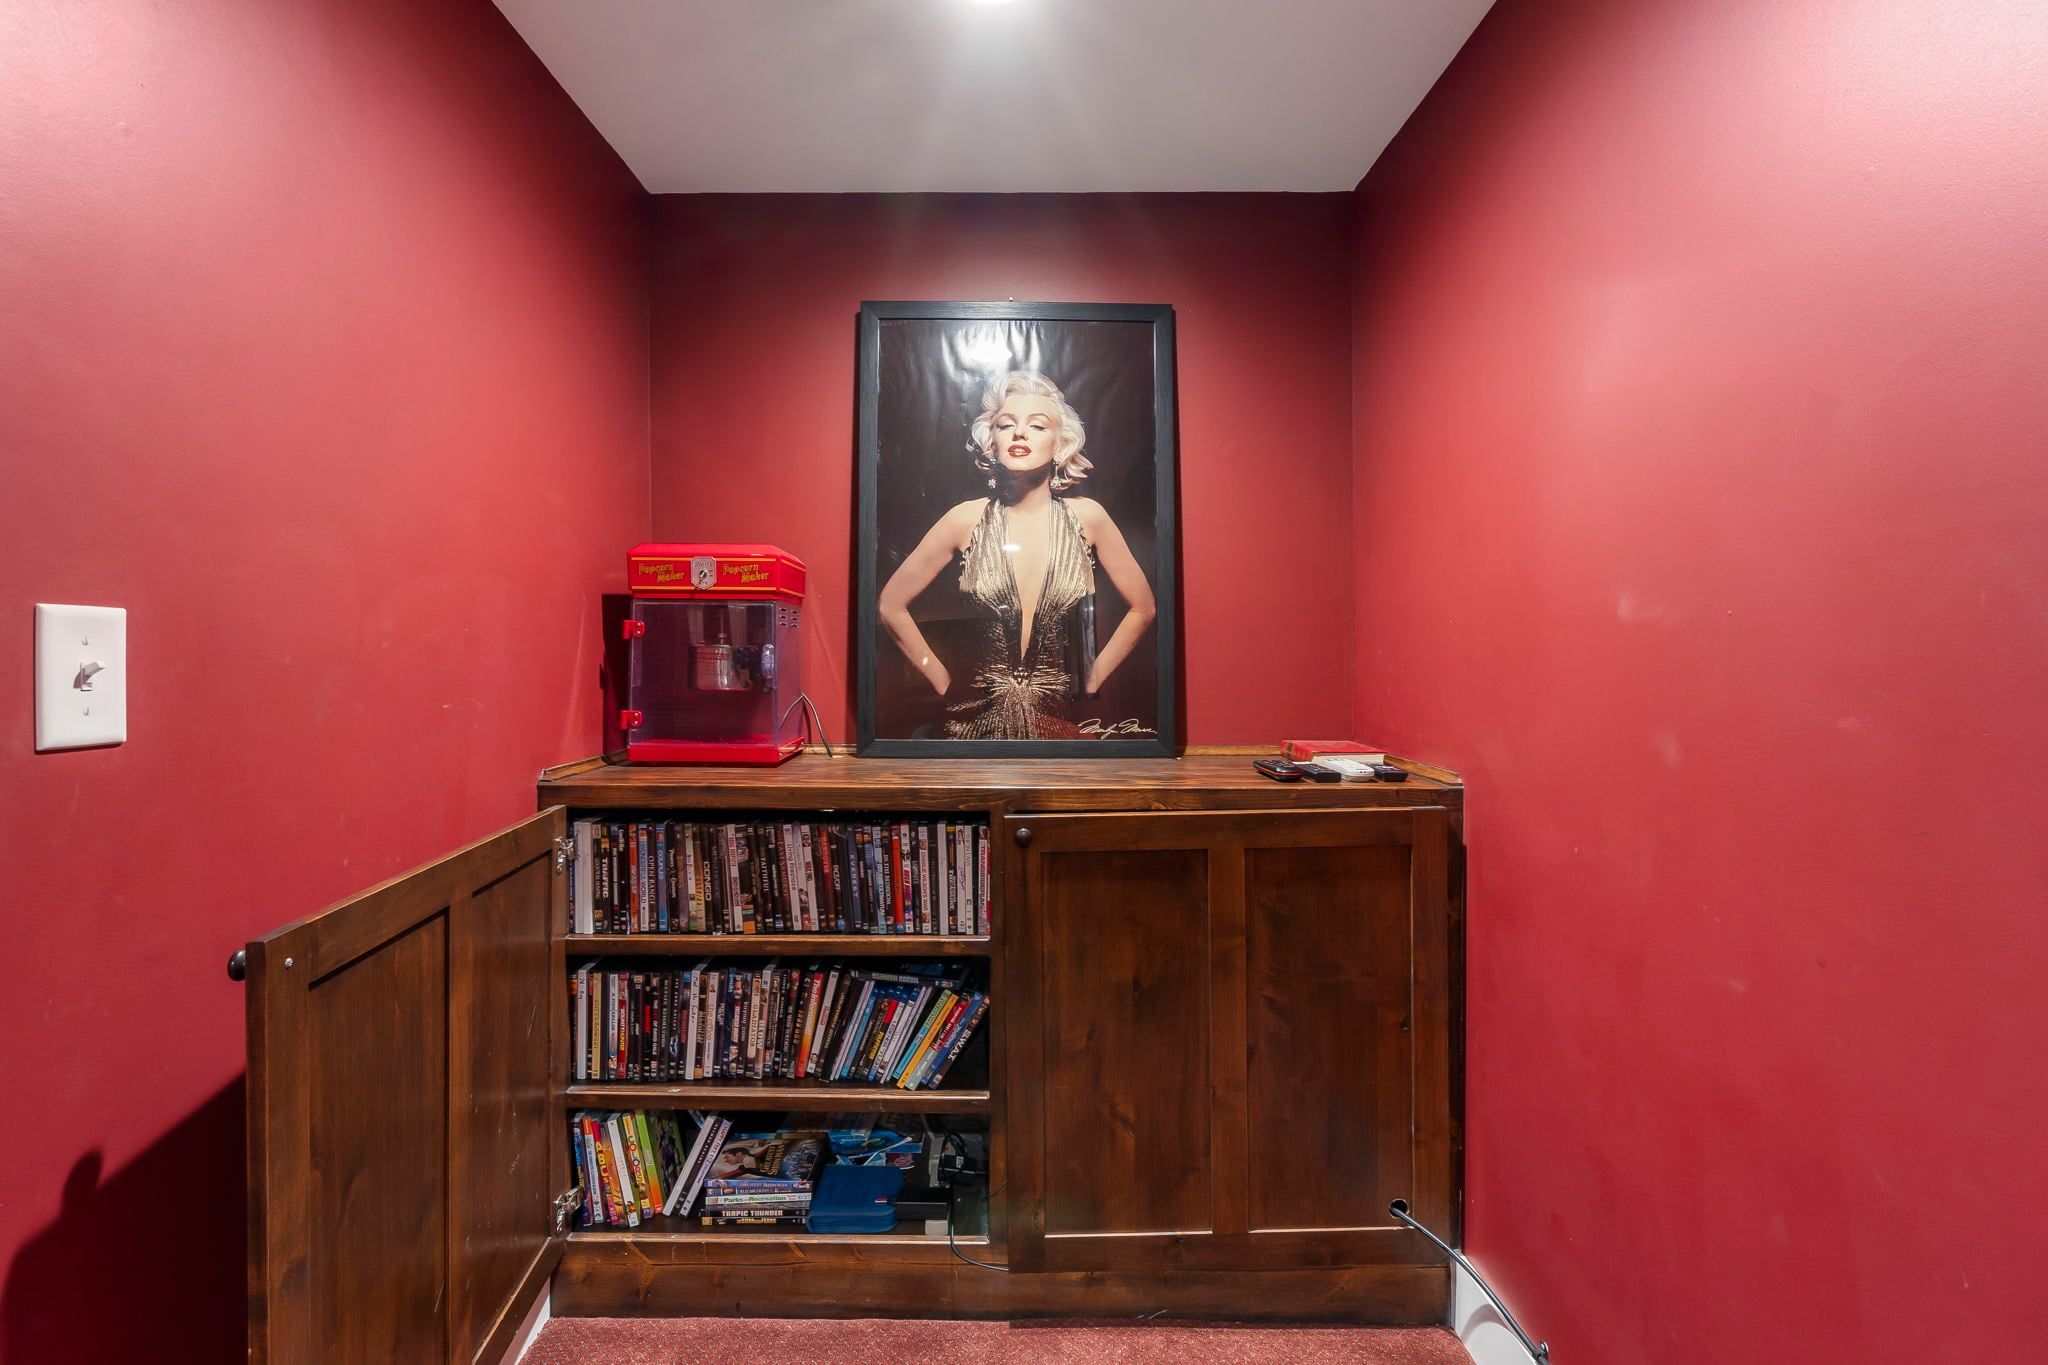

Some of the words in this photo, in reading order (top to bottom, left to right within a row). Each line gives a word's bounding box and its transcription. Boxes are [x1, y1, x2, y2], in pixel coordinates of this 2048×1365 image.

[639, 564, 674, 575] Popcorn
[657, 572, 684, 582] Maker
[723, 564, 758, 575] Popcorn
[741, 572, 768, 583] Maker
[703, 861, 712, 901] CONGO
[779, 860, 789, 896] SAMURAI
[789, 863, 797, 891] Fireplace
[850, 854, 858, 897] EVEREST
[750, 1004, 758, 1047] GLADIATOR
[757, 1020, 765, 1049] BLOW
[948, 1029, 971, 1061] S.W.A.T.
[627, 1136, 645, 1184] COLORS
